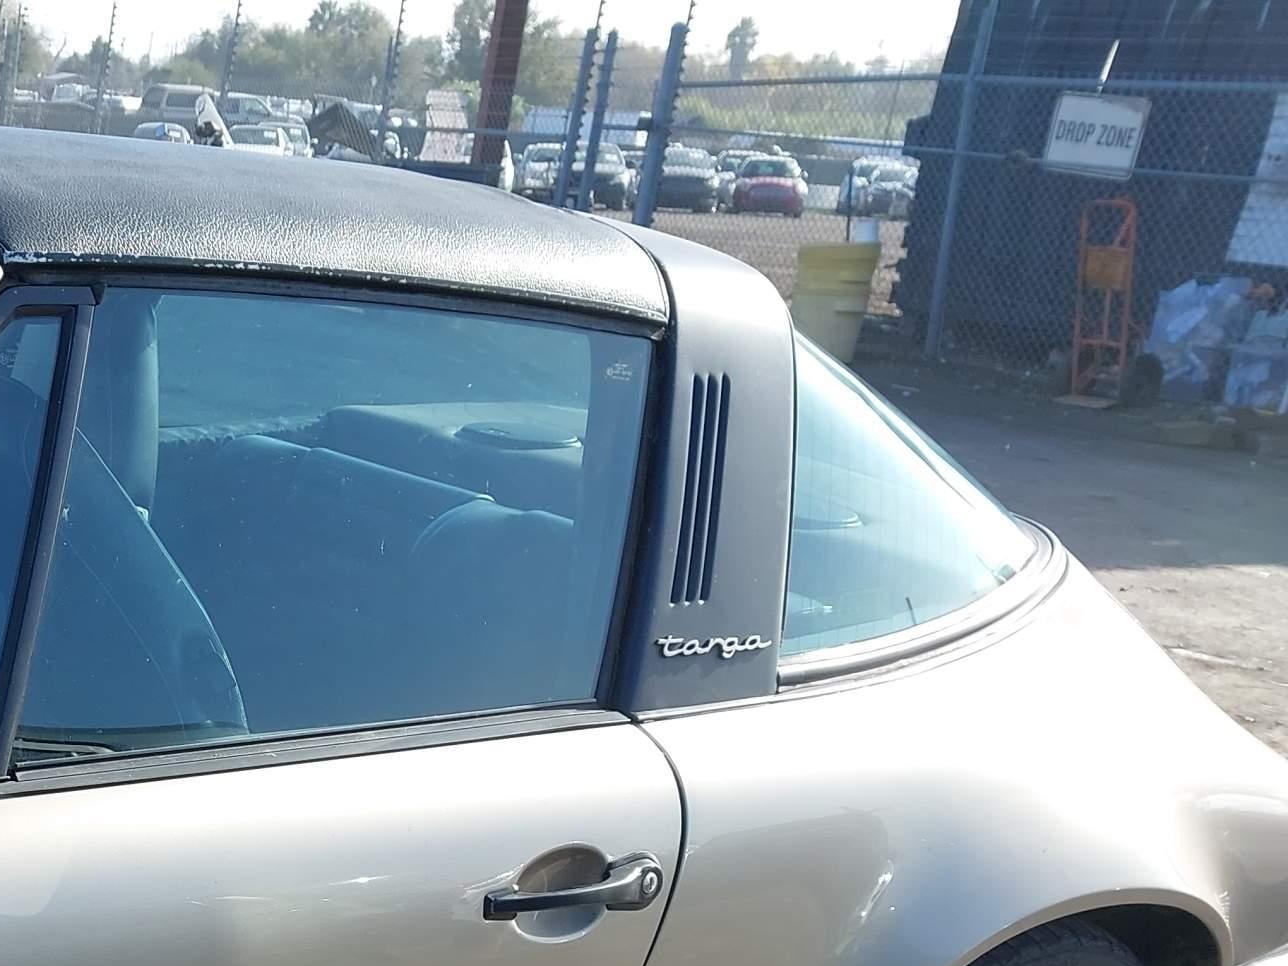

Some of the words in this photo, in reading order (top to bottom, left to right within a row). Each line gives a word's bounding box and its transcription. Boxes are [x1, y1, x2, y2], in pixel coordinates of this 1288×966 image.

[1055, 119, 1096, 144] DROP
[1096, 124, 1138, 149] ZONE
[655, 634, 772, 659] targa
